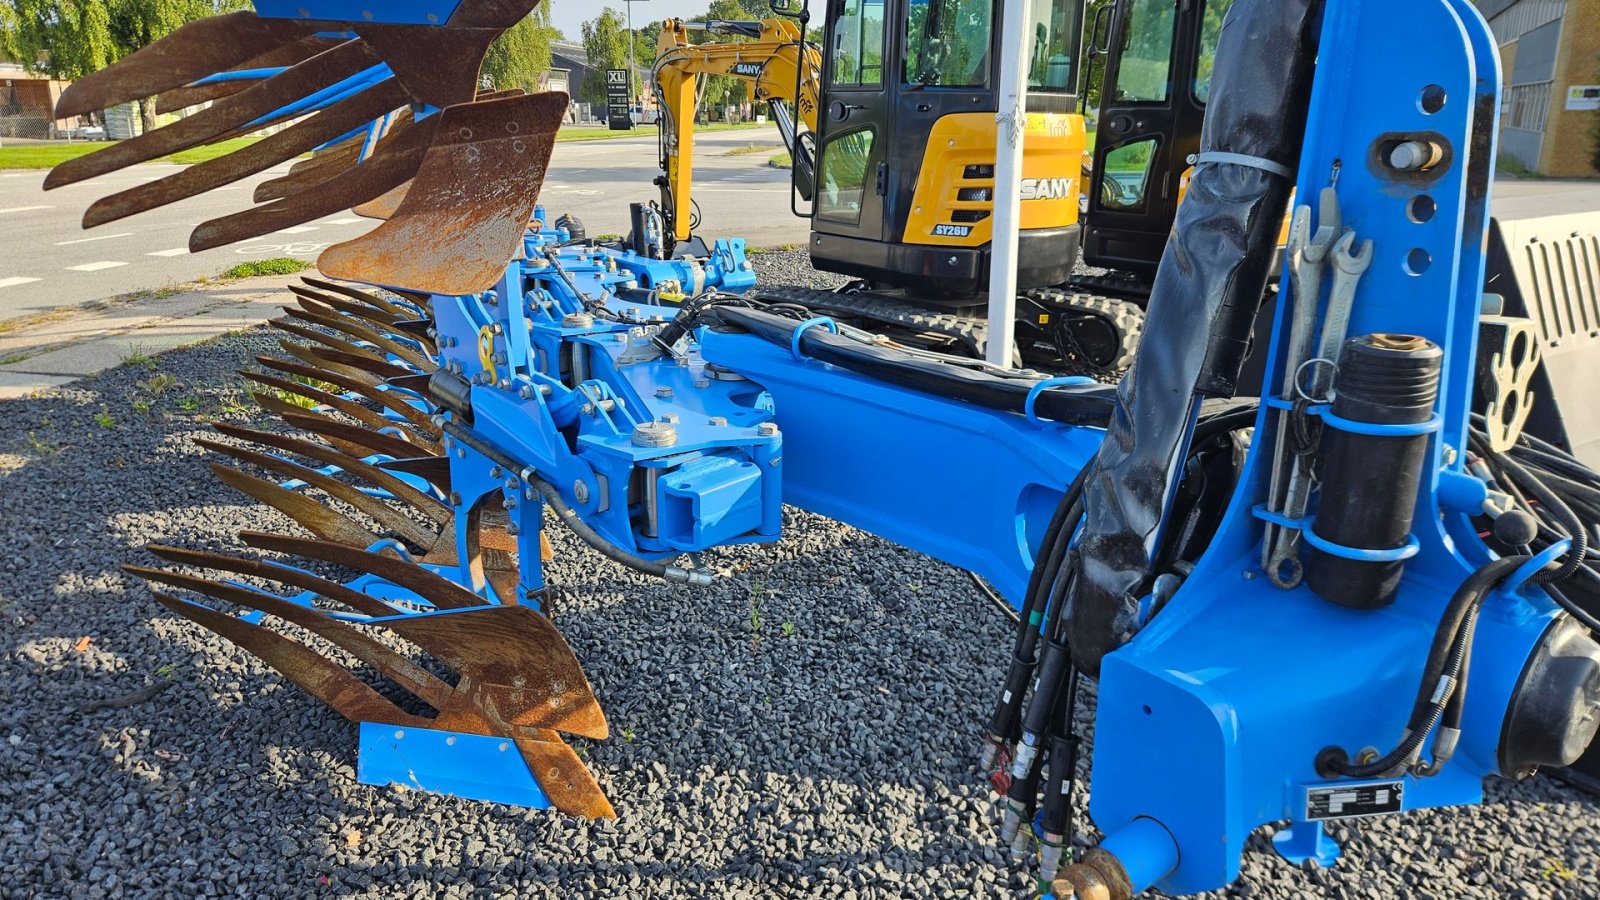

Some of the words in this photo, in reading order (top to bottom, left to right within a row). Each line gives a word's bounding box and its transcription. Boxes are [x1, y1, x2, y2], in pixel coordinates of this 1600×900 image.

[737, 64, 760, 75] SANY
[1020, 178, 1072, 200] SANY
[936, 225, 969, 237] SY26U
